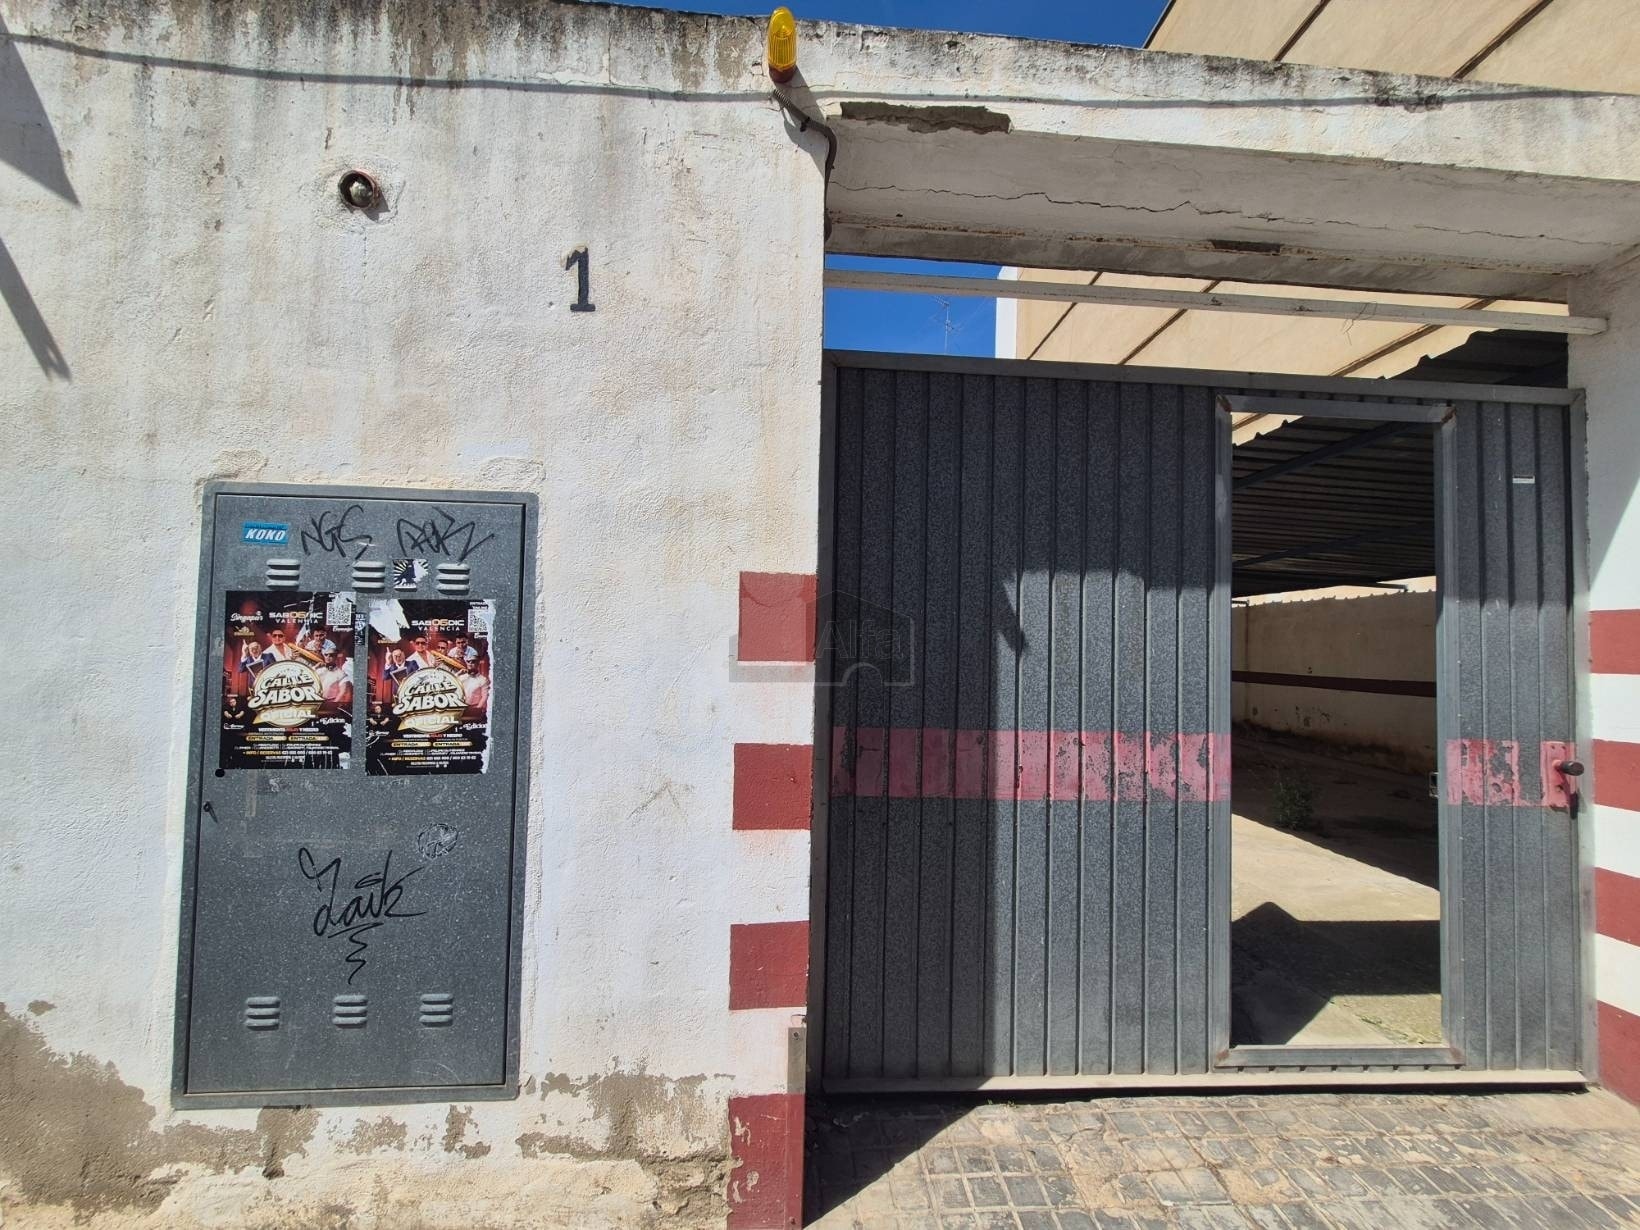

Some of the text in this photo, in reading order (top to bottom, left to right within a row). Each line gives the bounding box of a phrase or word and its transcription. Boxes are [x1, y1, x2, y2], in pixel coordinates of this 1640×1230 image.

[565, 246, 596, 313] 1
[245, 528, 286, 541] KOKO
[247, 687, 324, 708] SABOR
[392, 692, 468, 714] SABOR
